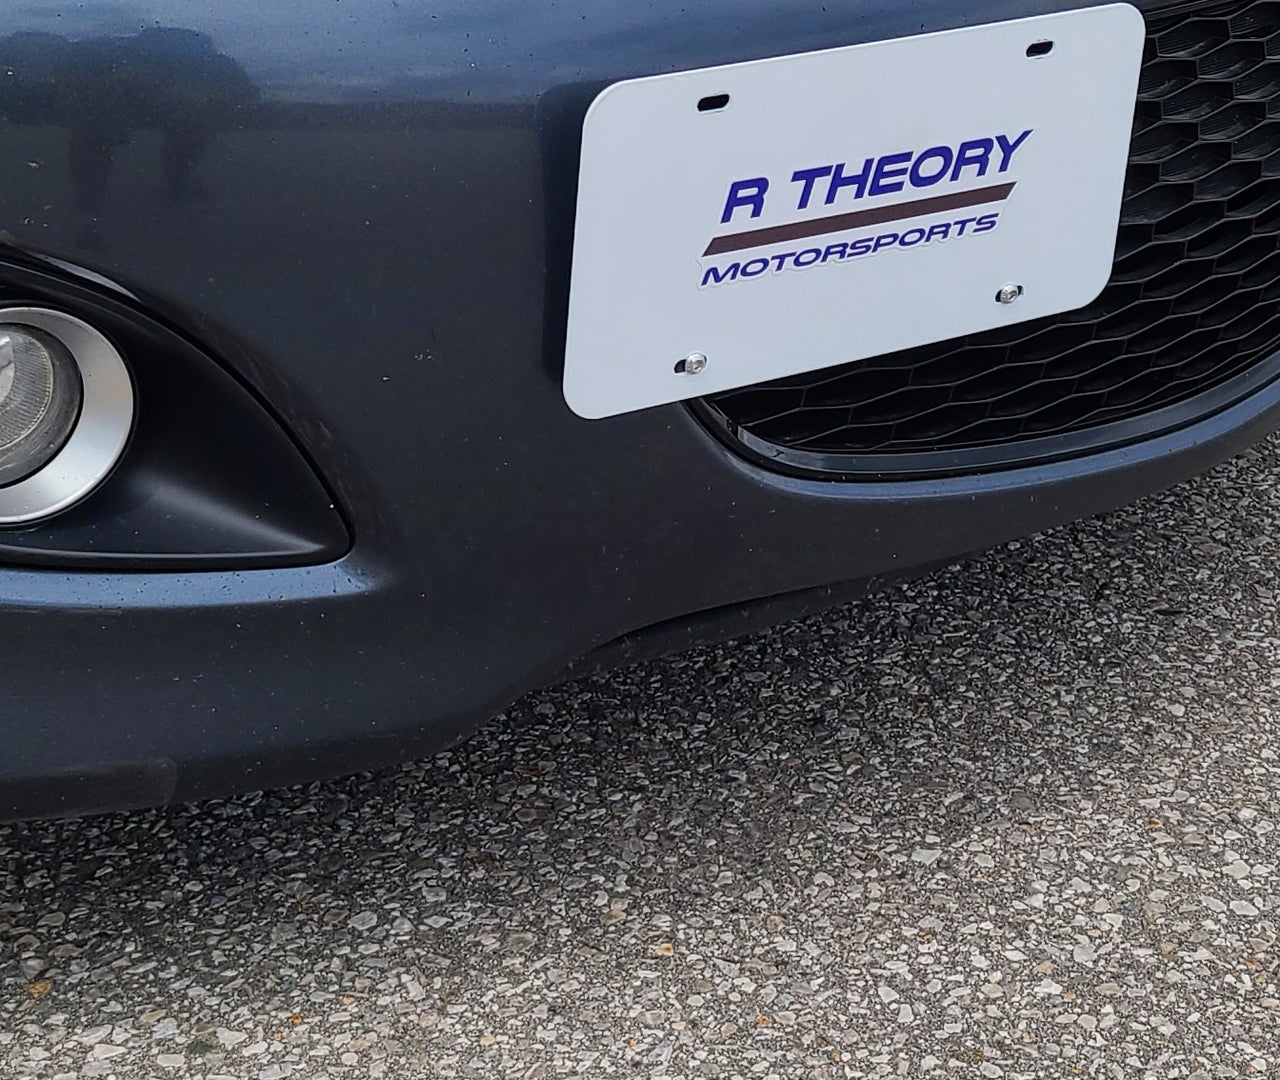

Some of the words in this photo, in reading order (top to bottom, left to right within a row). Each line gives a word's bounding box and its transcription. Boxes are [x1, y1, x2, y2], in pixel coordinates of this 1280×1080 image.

[720, 177, 769, 224] R
[791, 129, 1033, 210] THEORY
[701, 213, 999, 285] MOTORSPORTS
